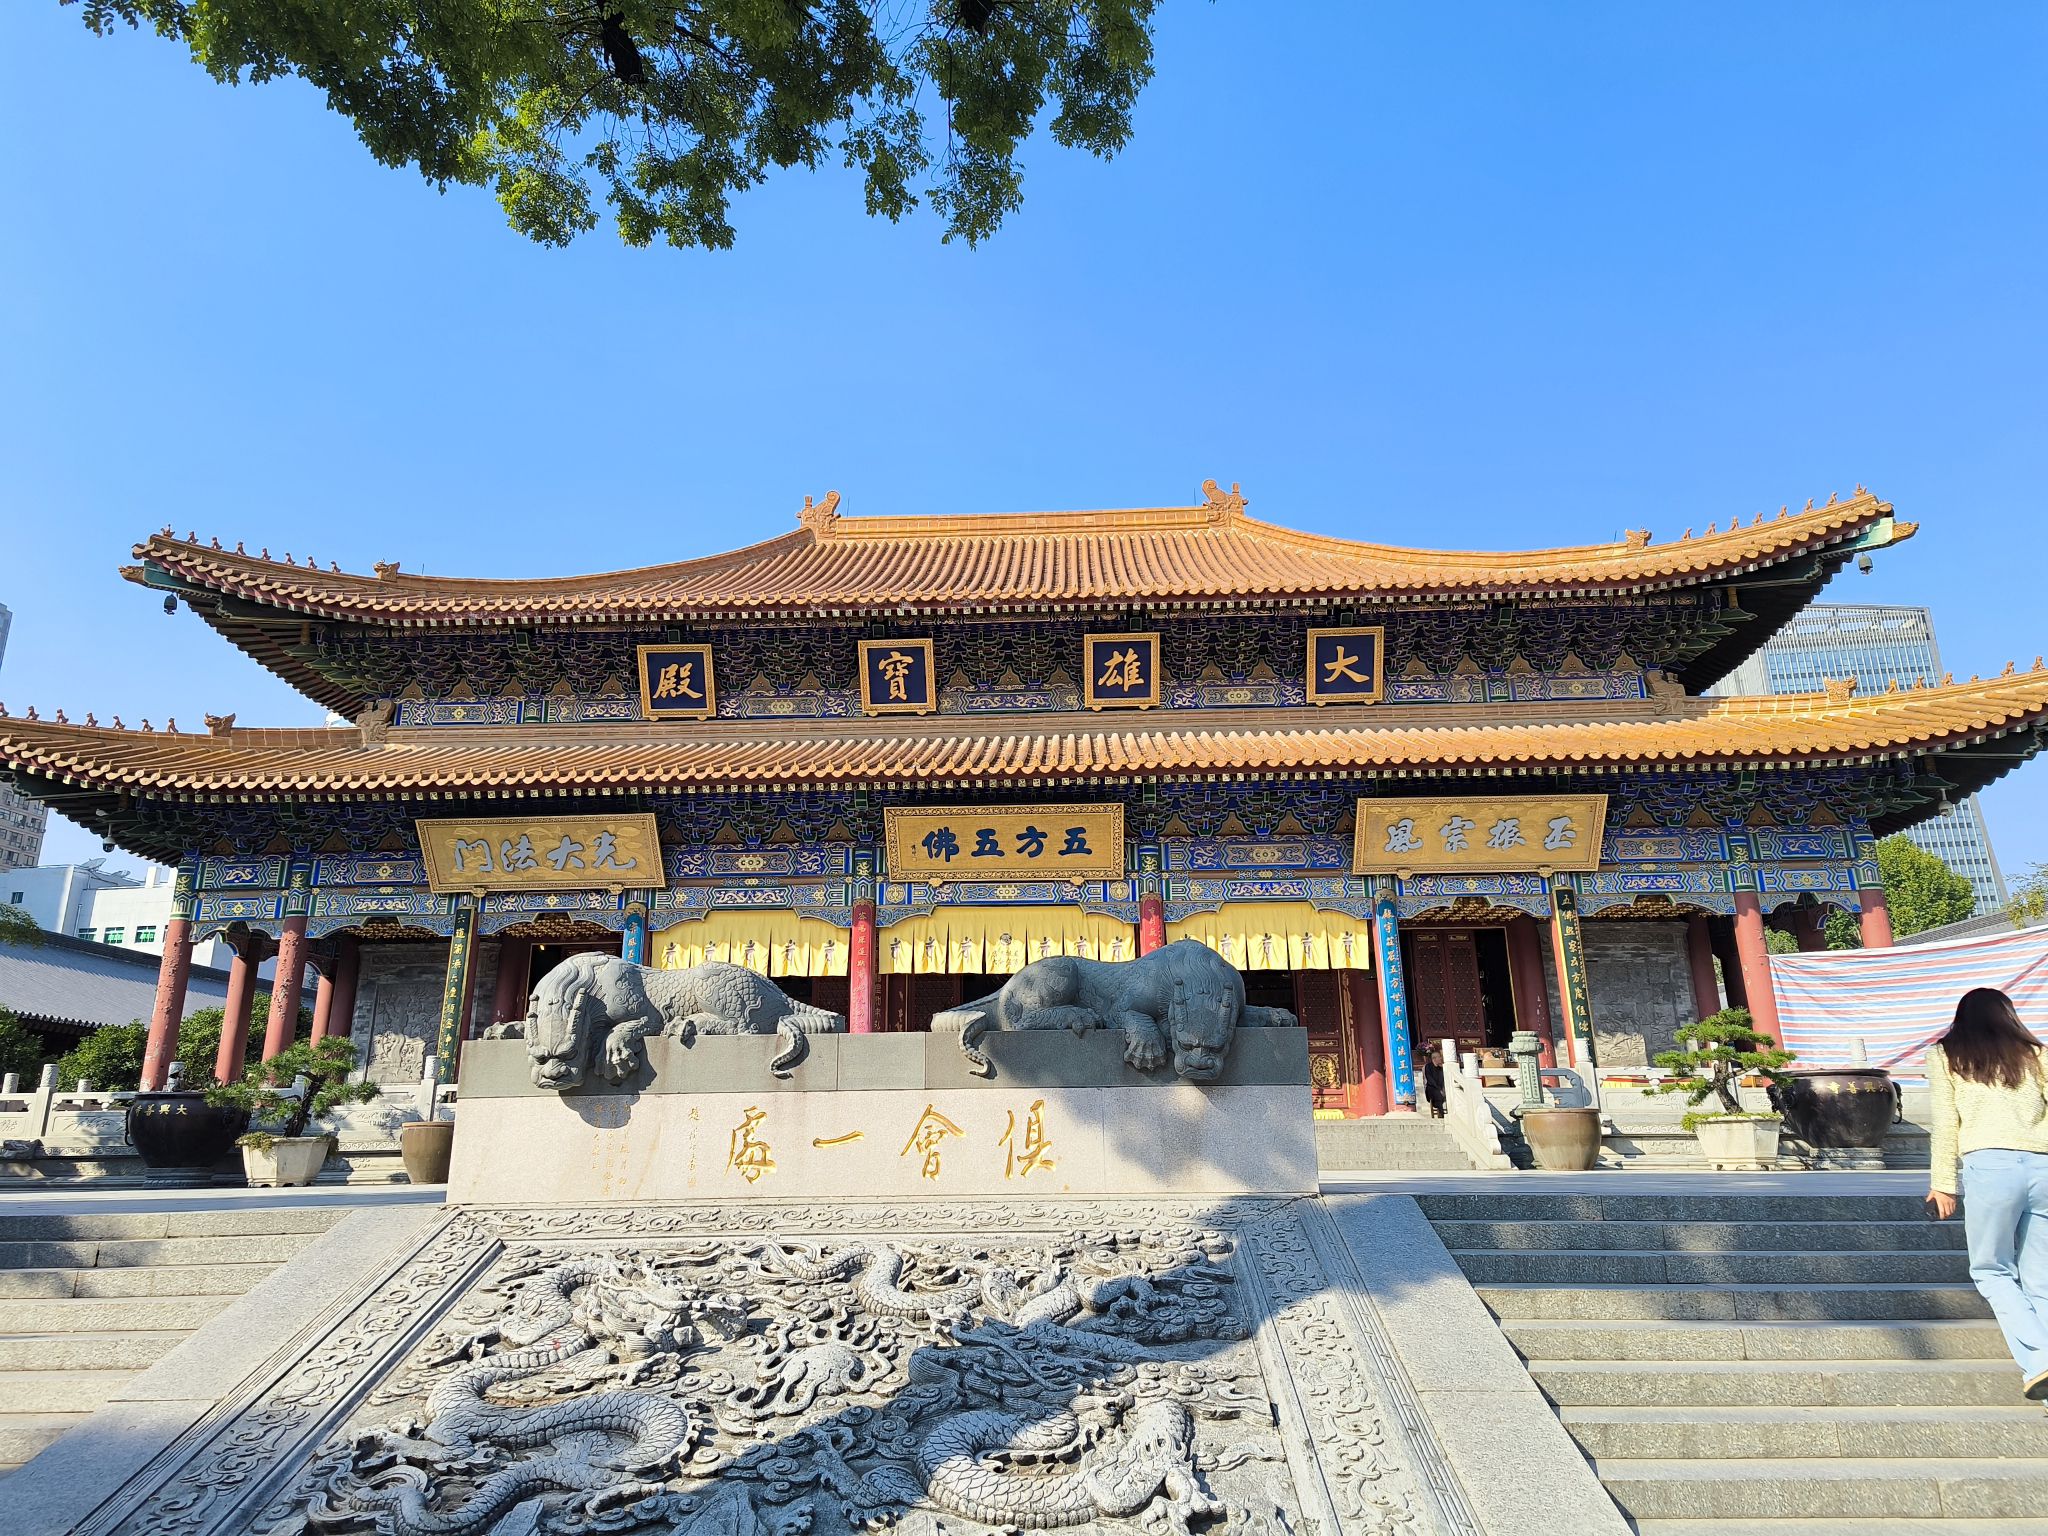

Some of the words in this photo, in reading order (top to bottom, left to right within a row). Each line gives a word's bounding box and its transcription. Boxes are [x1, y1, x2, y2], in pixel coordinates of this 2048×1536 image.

[652, 662, 703, 699] 殿
[878, 651, 914, 701] 寶
[1098, 647, 1145, 692] 雄
[1324, 645, 1370, 683] 大
[921, 825, 1093, 863] 五方五佛
